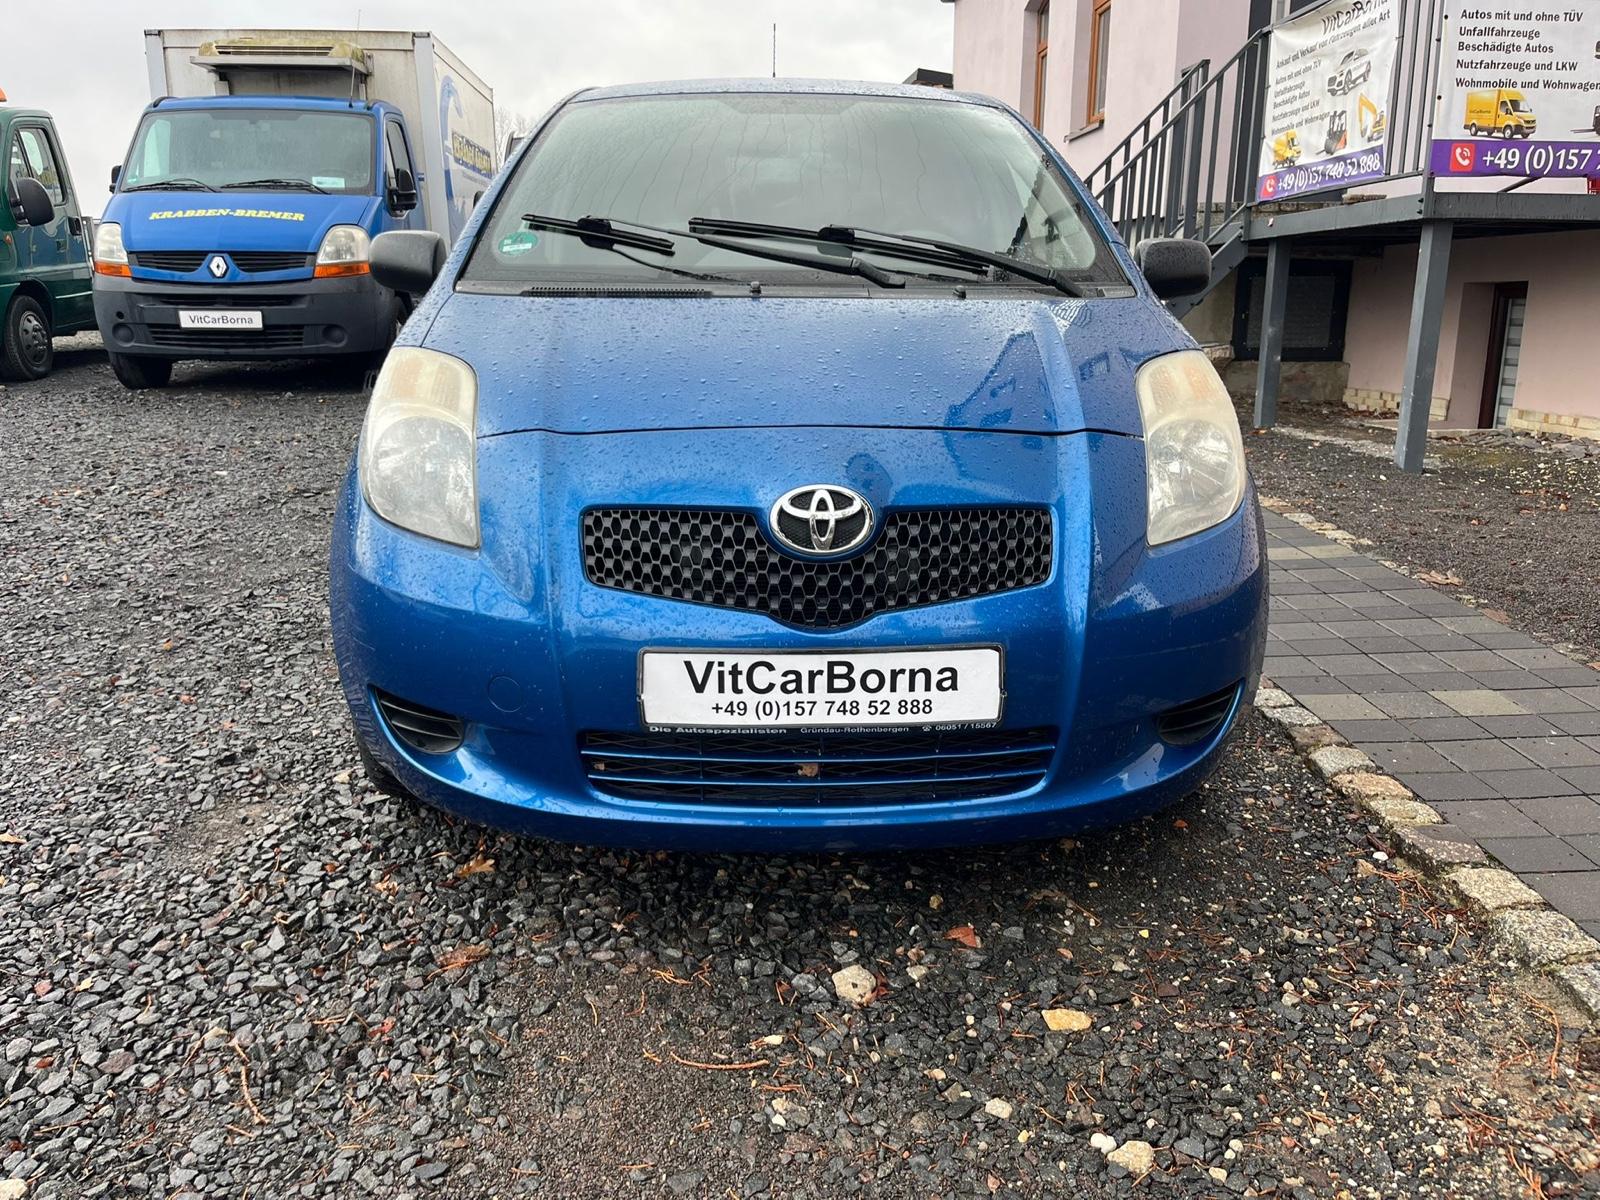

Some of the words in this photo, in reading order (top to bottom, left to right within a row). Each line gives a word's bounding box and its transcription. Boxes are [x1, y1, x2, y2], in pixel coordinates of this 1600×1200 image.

[1379, 9, 1390, 23] Art
[1461, 9, 1492, 20] Autos
[1495, 10, 1510, 20] mit
[1514, 11, 1532, 21] und
[1535, 11, 1560, 22] ohne
[1563, 9, 1583, 22] TÜV
[1459, 26, 1541, 40] Unfallfahrzeuge
[1458, 41, 1522, 54] Beschädigte
[1524, 43, 1554, 53] Autos
[1456, 59, 1531, 72] Nutzfahrzeuge
[1534, 61, 1552, 71] und
[1556, 61, 1578, 71] LKW
[1455, 78, 1518, 89] Wohnmobile
[1521, 79, 1539, 89] und
[1482, 148, 1520, 169] +49
[1525, 145, 1593, 175] (0)157
[1278, 173, 1294, 190] +49
[1295, 165, 1322, 191] (0)157
[1325, 162, 1345, 180] 748
[1344, 158, 1358, 177] 52
[1359, 152, 1380, 174] 888
[149, 208, 305, 221] KRABBEN-BREMER
[189, 314, 254, 325] VitCarBorna
[683, 660, 959, 695] VitCarBorna
[711, 701, 748, 717] +49
[755, 700, 817, 720] (0)157
[825, 700, 860, 716] 748
[867, 700, 890, 716] 52
[897, 699, 933, 715] 888
[676, 726, 787, 735] Autospezialisten
